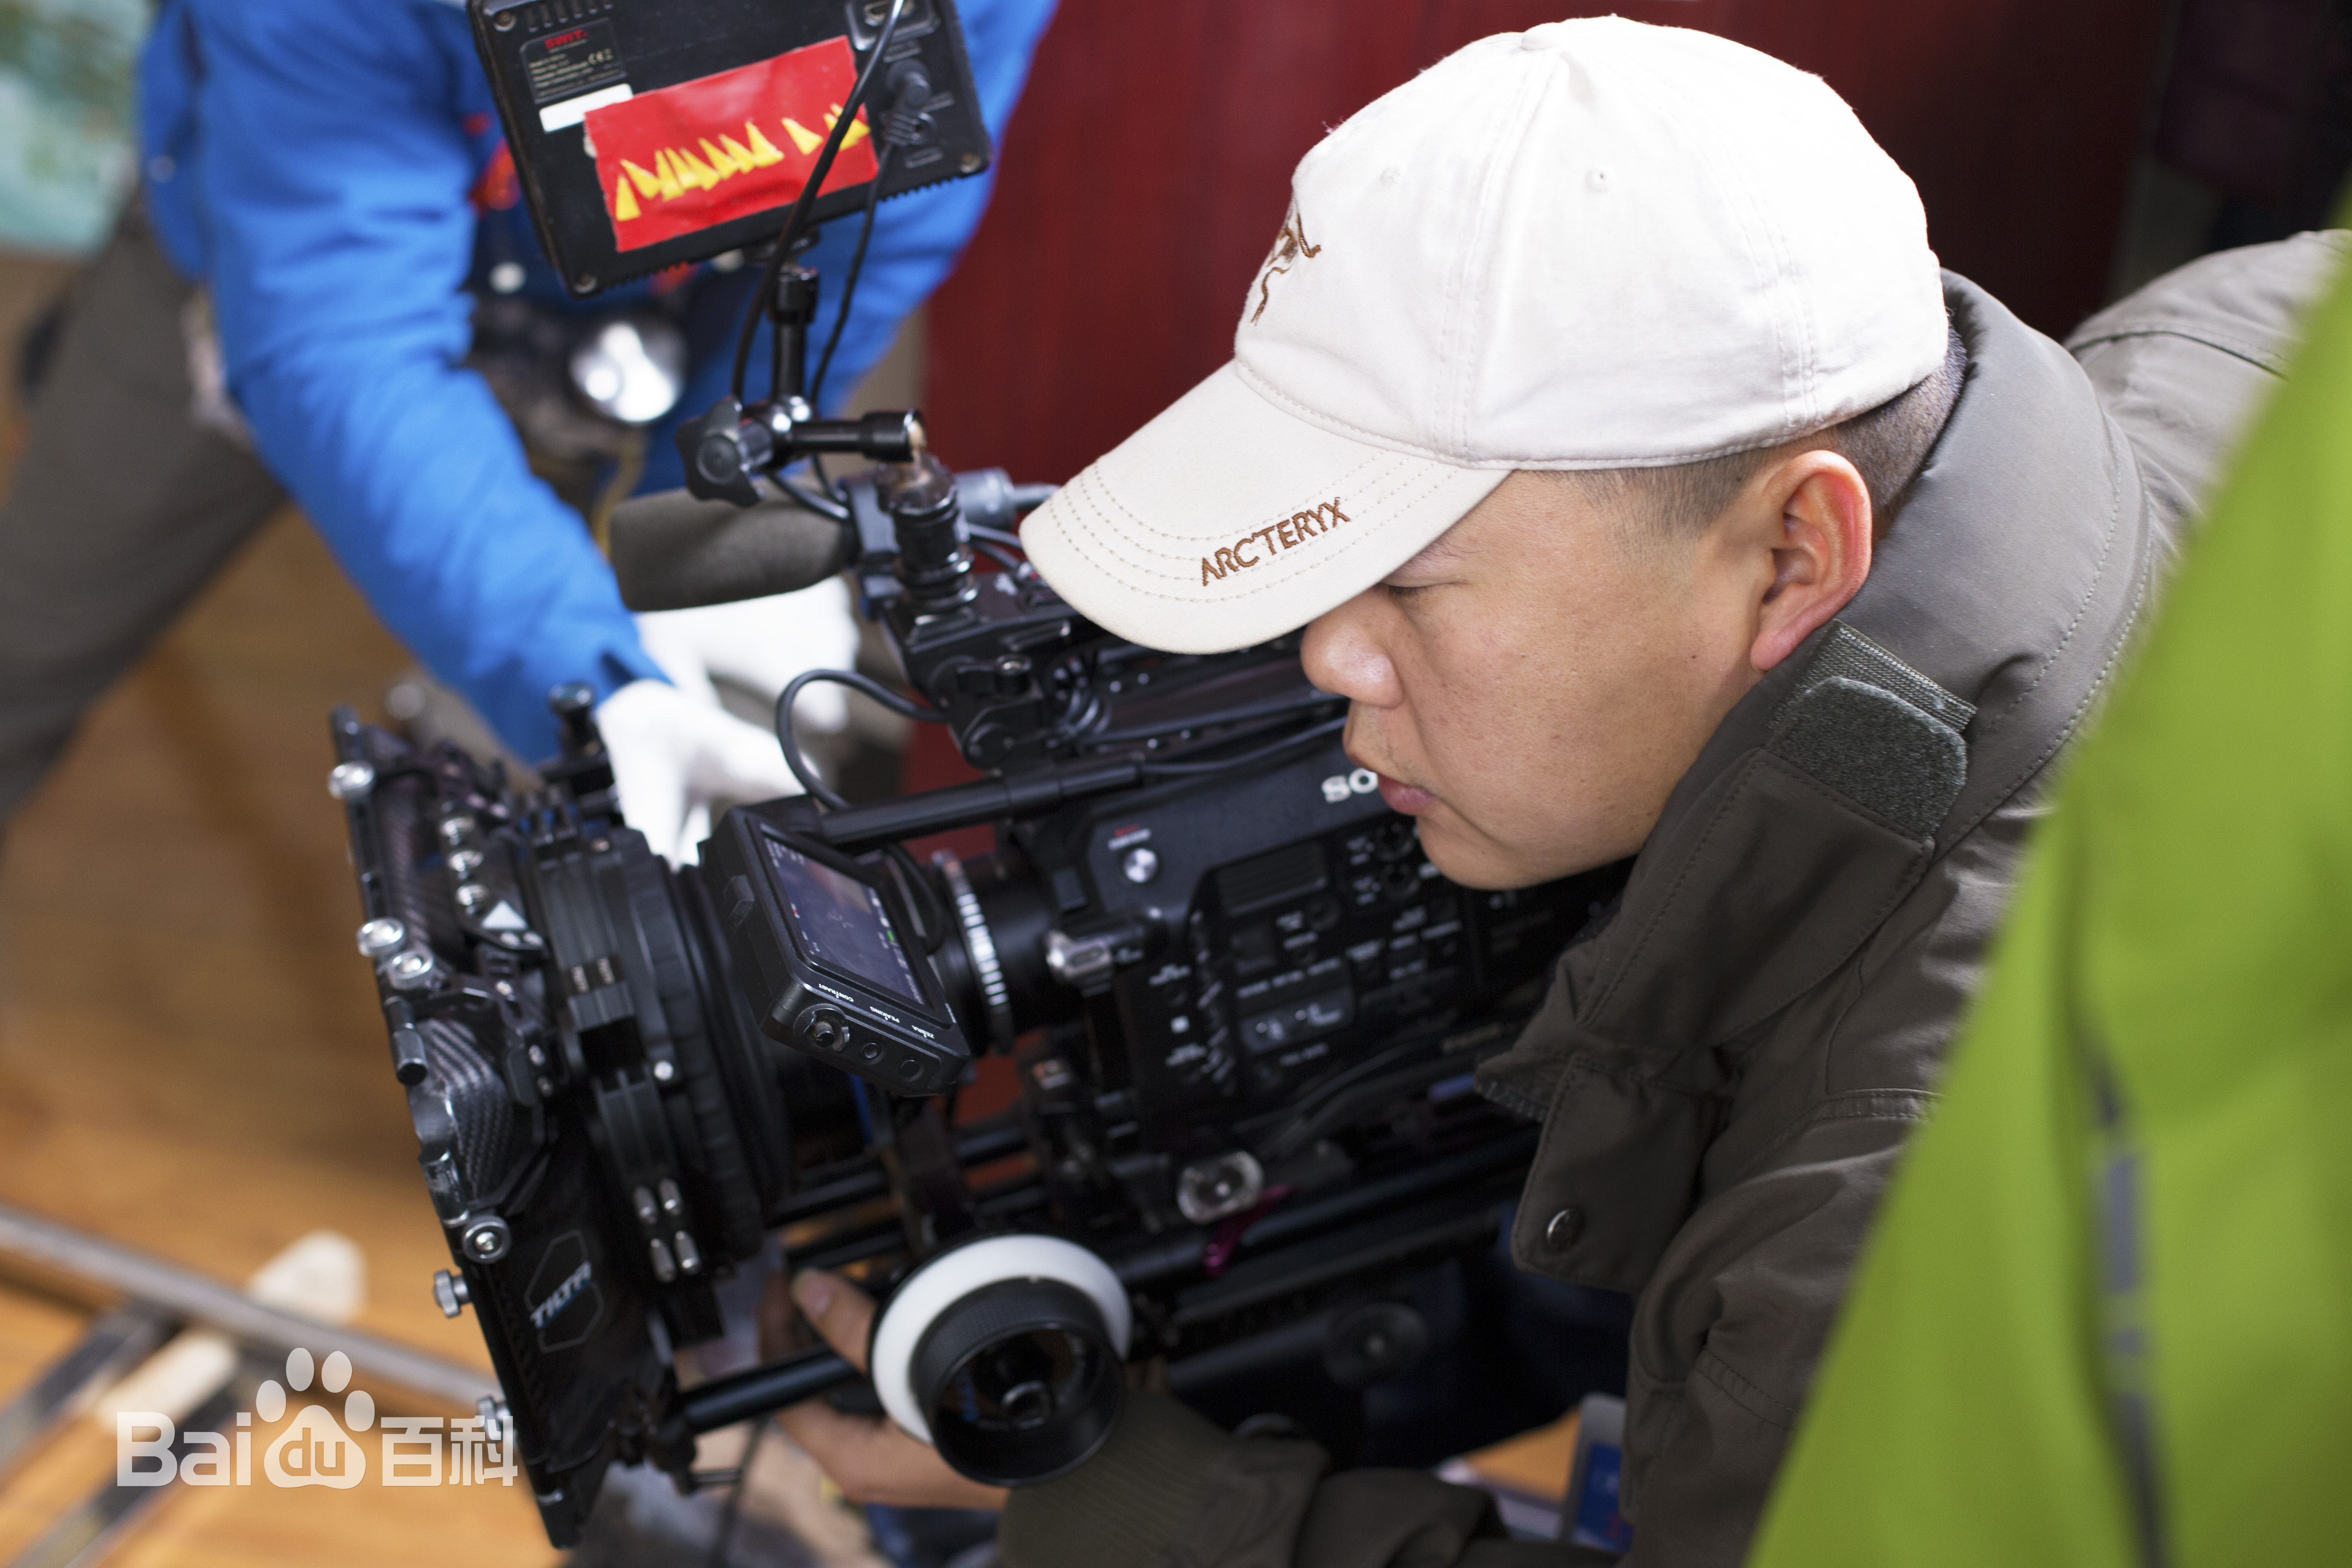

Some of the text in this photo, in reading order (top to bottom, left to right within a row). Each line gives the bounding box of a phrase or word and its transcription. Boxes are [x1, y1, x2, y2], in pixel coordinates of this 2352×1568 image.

[1321, 767, 1378, 804] SO
[818, 983, 854, 1003] CONTRAST
[870, 1006, 900, 1023] PEAKING
[911, 1025, 935, 1039] ZEBRA
